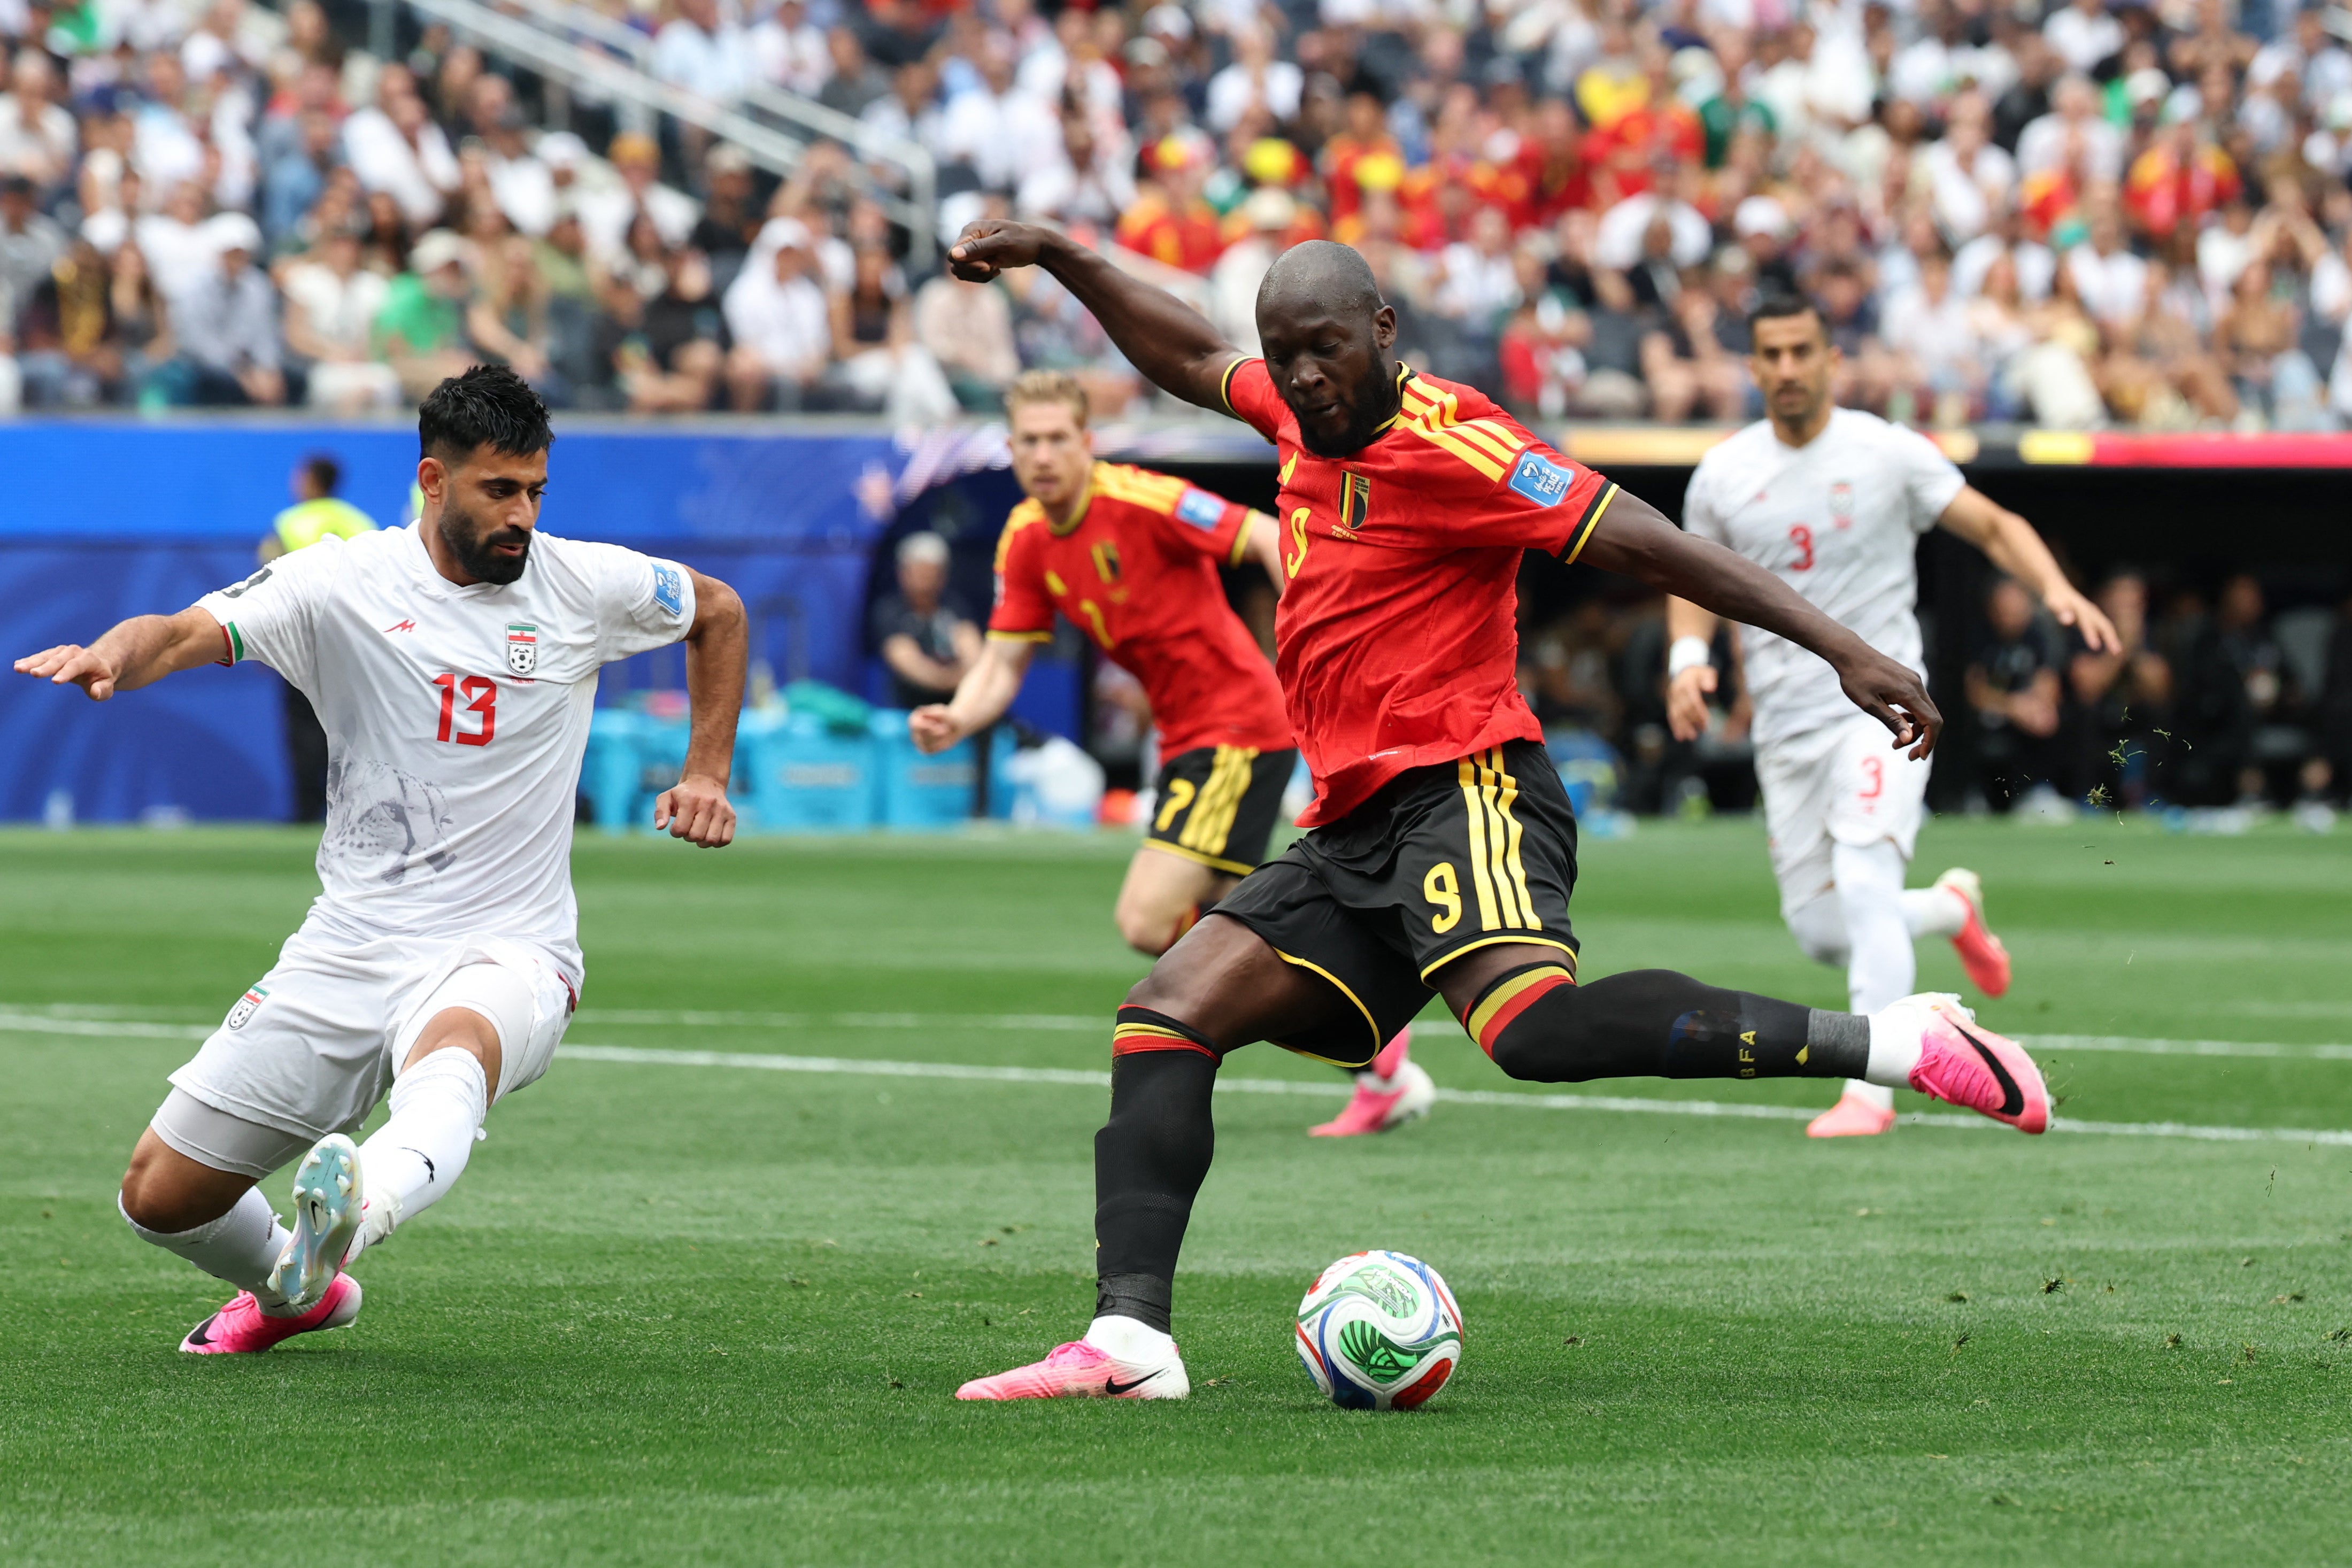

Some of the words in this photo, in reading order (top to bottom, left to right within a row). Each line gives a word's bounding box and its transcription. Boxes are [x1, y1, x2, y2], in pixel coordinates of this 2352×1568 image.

[1543, 472, 1560, 495] PEACE
[1554, 481, 1564, 494] FIFA
[1286, 507, 1311, 579] 9
[1788, 524, 1815, 571] 3
[1079, 599, 1115, 650] 7
[433, 674, 497, 746] 13
[1859, 755, 1883, 799] 3
[1156, 778, 1196, 832] 7
[1423, 862, 1462, 934] 9
[1739, 1030, 1757, 1078] BFA
